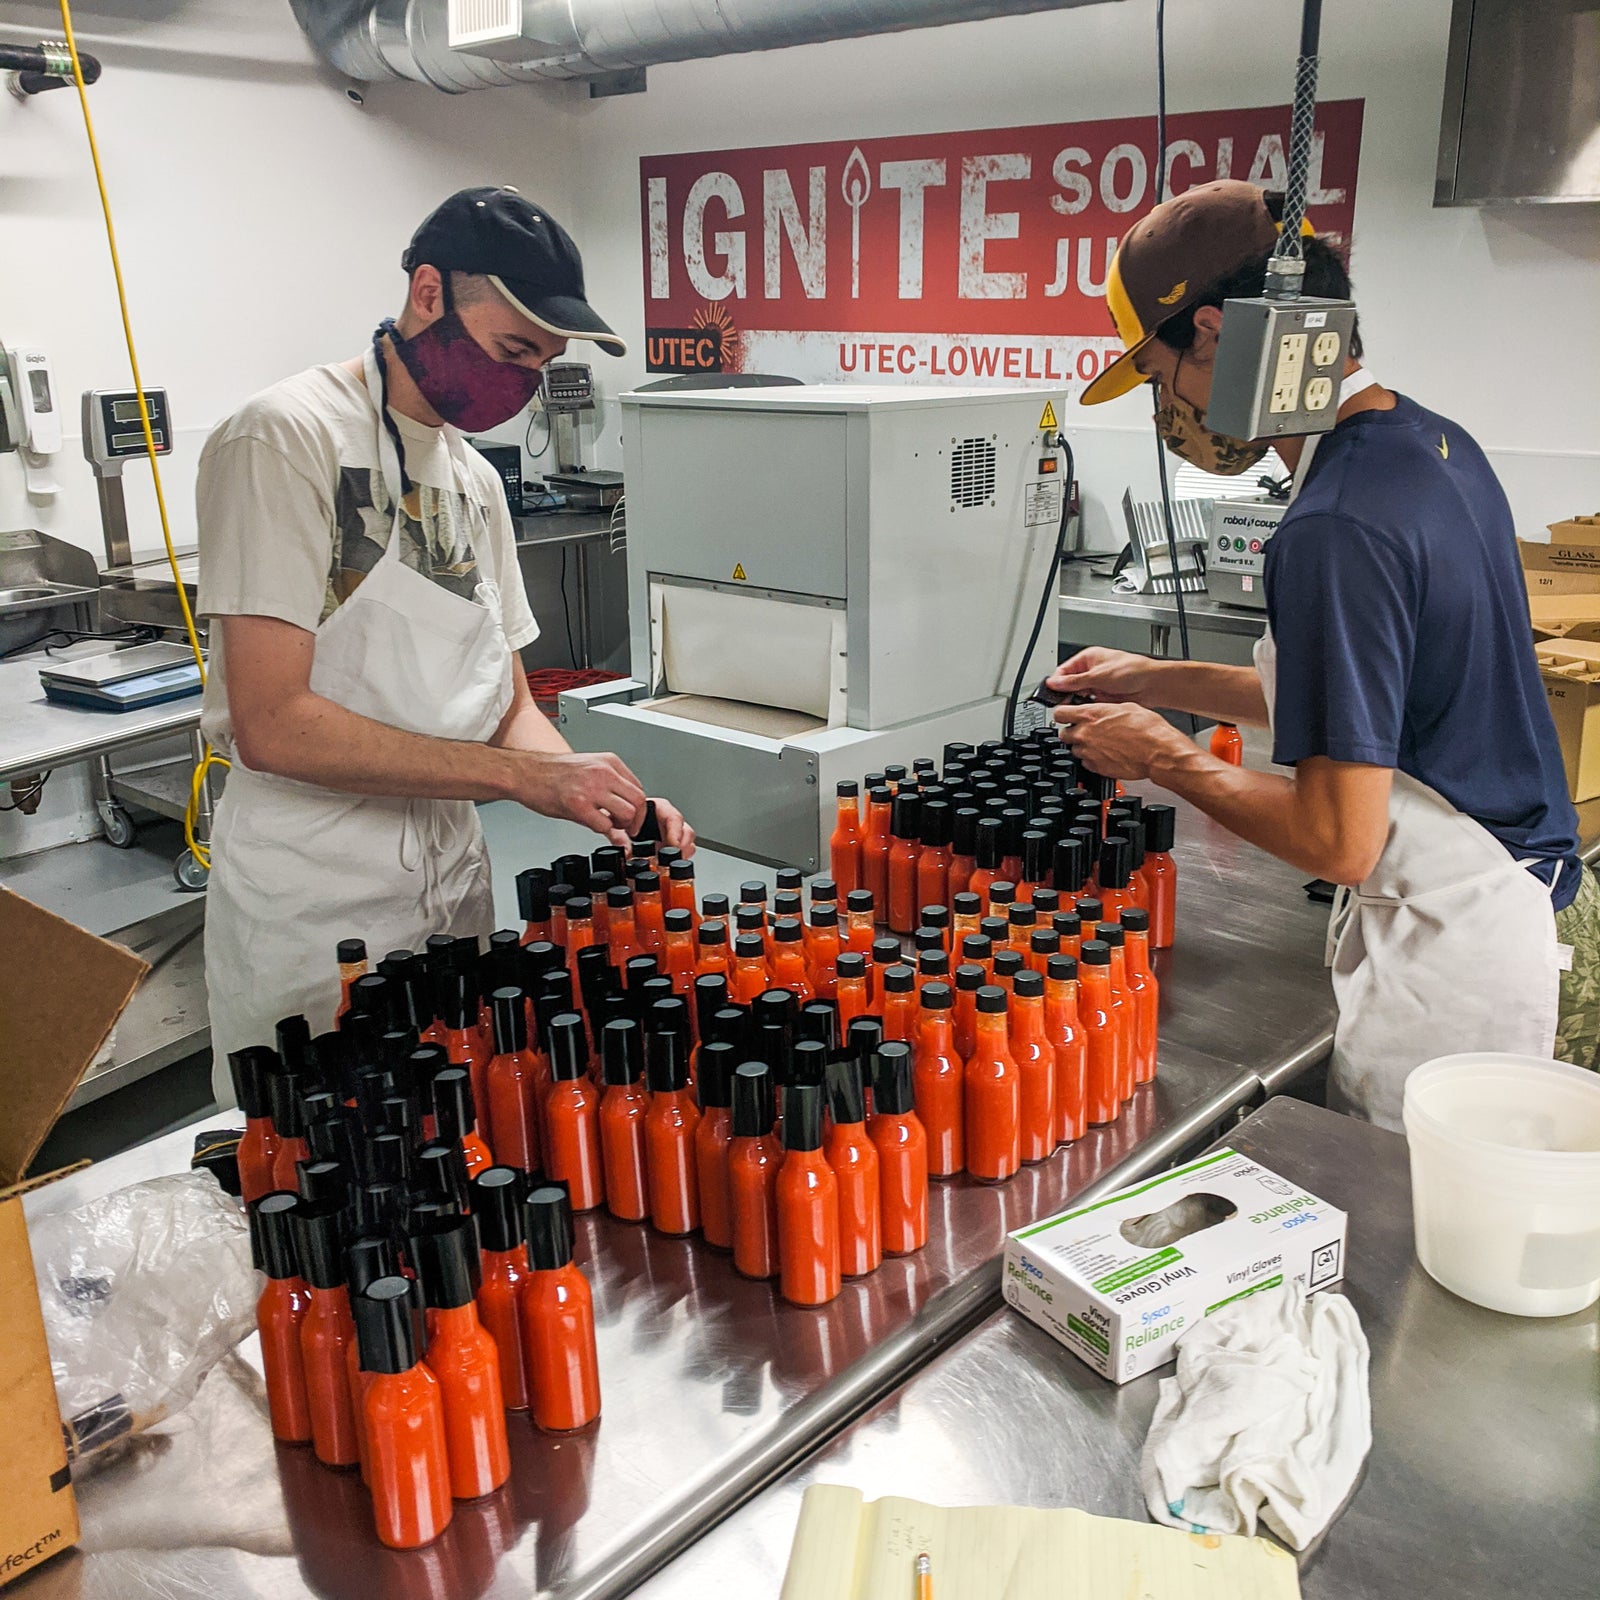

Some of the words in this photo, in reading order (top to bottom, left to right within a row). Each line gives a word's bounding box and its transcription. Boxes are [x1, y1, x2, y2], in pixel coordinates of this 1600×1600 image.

[1050, 130, 1346, 215] SOCIAL
[648, 146, 1031, 300] IGNITE
[648, 335, 715, 368] UTEC
[1223, 516, 1247, 525] robot
[1558, 550, 1595, 559] GLASS
[1539, 578, 1553, 586] 12/1
[1555, 690, 1566, 698] oz
[1233, 1166, 1260, 1178] Sysco
[1248, 1195, 1318, 1224] Reliance
[1282, 1212, 1318, 1229] Sysco
[1020, 1255, 1044, 1280] Sysco
[1160, 1266, 1198, 1287] Vinyl
[1227, 1266, 1250, 1284] Vinyl
[1251, 1253, 1282, 1273] Gloves
[1008, 1261, 1054, 1305] Reliance
[1115, 1281, 1161, 1305] Gloves
[1081, 1311, 1109, 1338] Gloves
[1089, 1304, 1111, 1328] Vinyl
[1141, 1305, 1171, 1326] Sysco
[1125, 1316, 1185, 1352] Reliance
